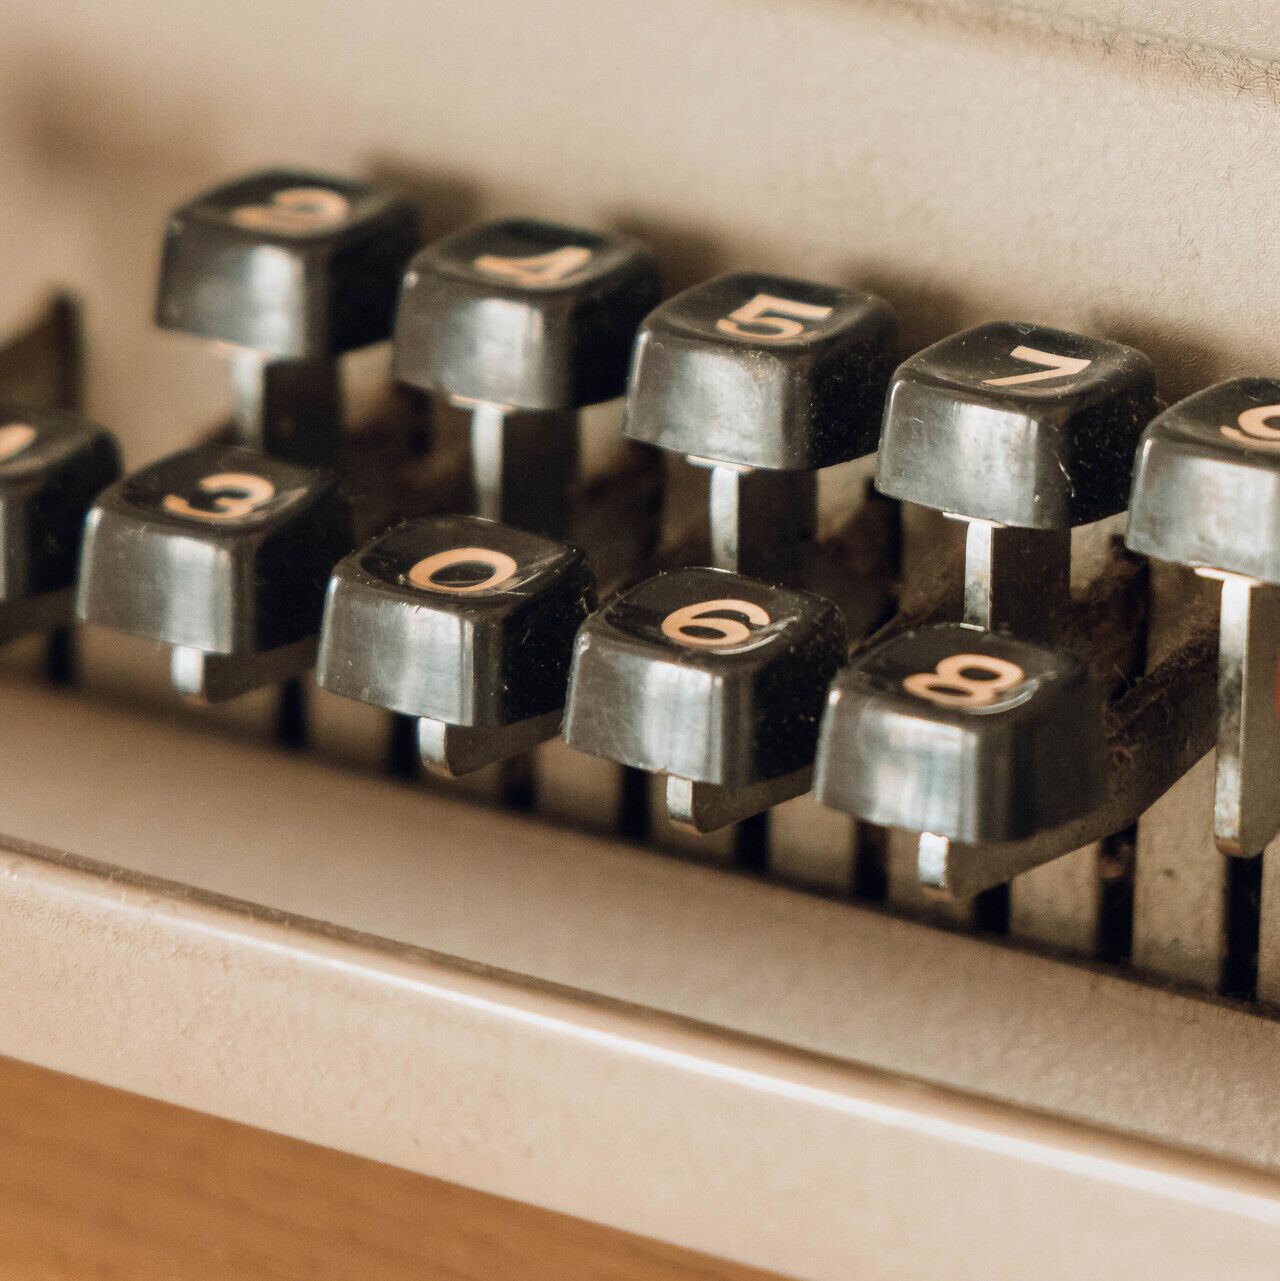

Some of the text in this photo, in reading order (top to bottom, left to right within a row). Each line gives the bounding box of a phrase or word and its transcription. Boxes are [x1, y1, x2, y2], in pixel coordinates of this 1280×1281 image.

[231, 187, 350, 237] 2
[475, 245, 593, 286] 4
[718, 294, 834, 343] 5
[983, 345, 1091, 388] 7
[164, 473, 275, 521] 3
[409, 546, 518, 593] 0
[660, 598, 770, 648] 6
[903, 653, 1026, 707] 8
